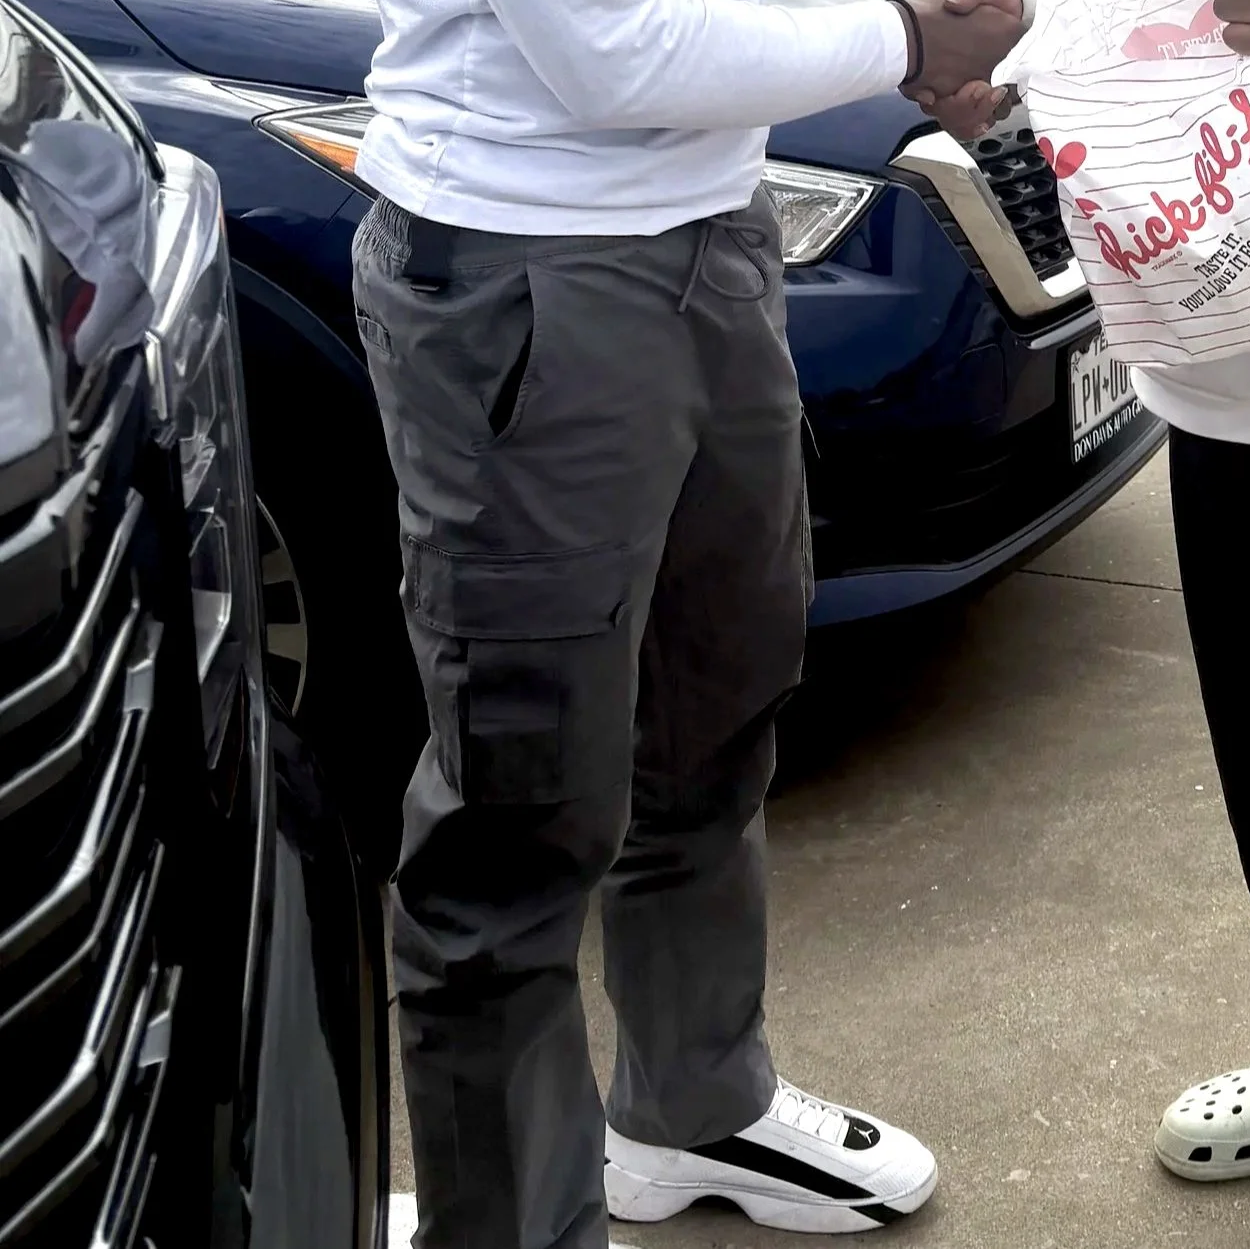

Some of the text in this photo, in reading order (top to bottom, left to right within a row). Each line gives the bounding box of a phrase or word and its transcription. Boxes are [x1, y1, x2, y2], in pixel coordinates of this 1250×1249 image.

[1178, 286, 1216, 312] YOU'LL
[1228, 254, 1249, 272] IT
[1194, 232, 1243, 278] TASTE IT.
[1074, 433, 1093, 463] DON
[1092, 420, 1113, 448] DAVIS
[1113, 405, 1131, 434] AUTO
